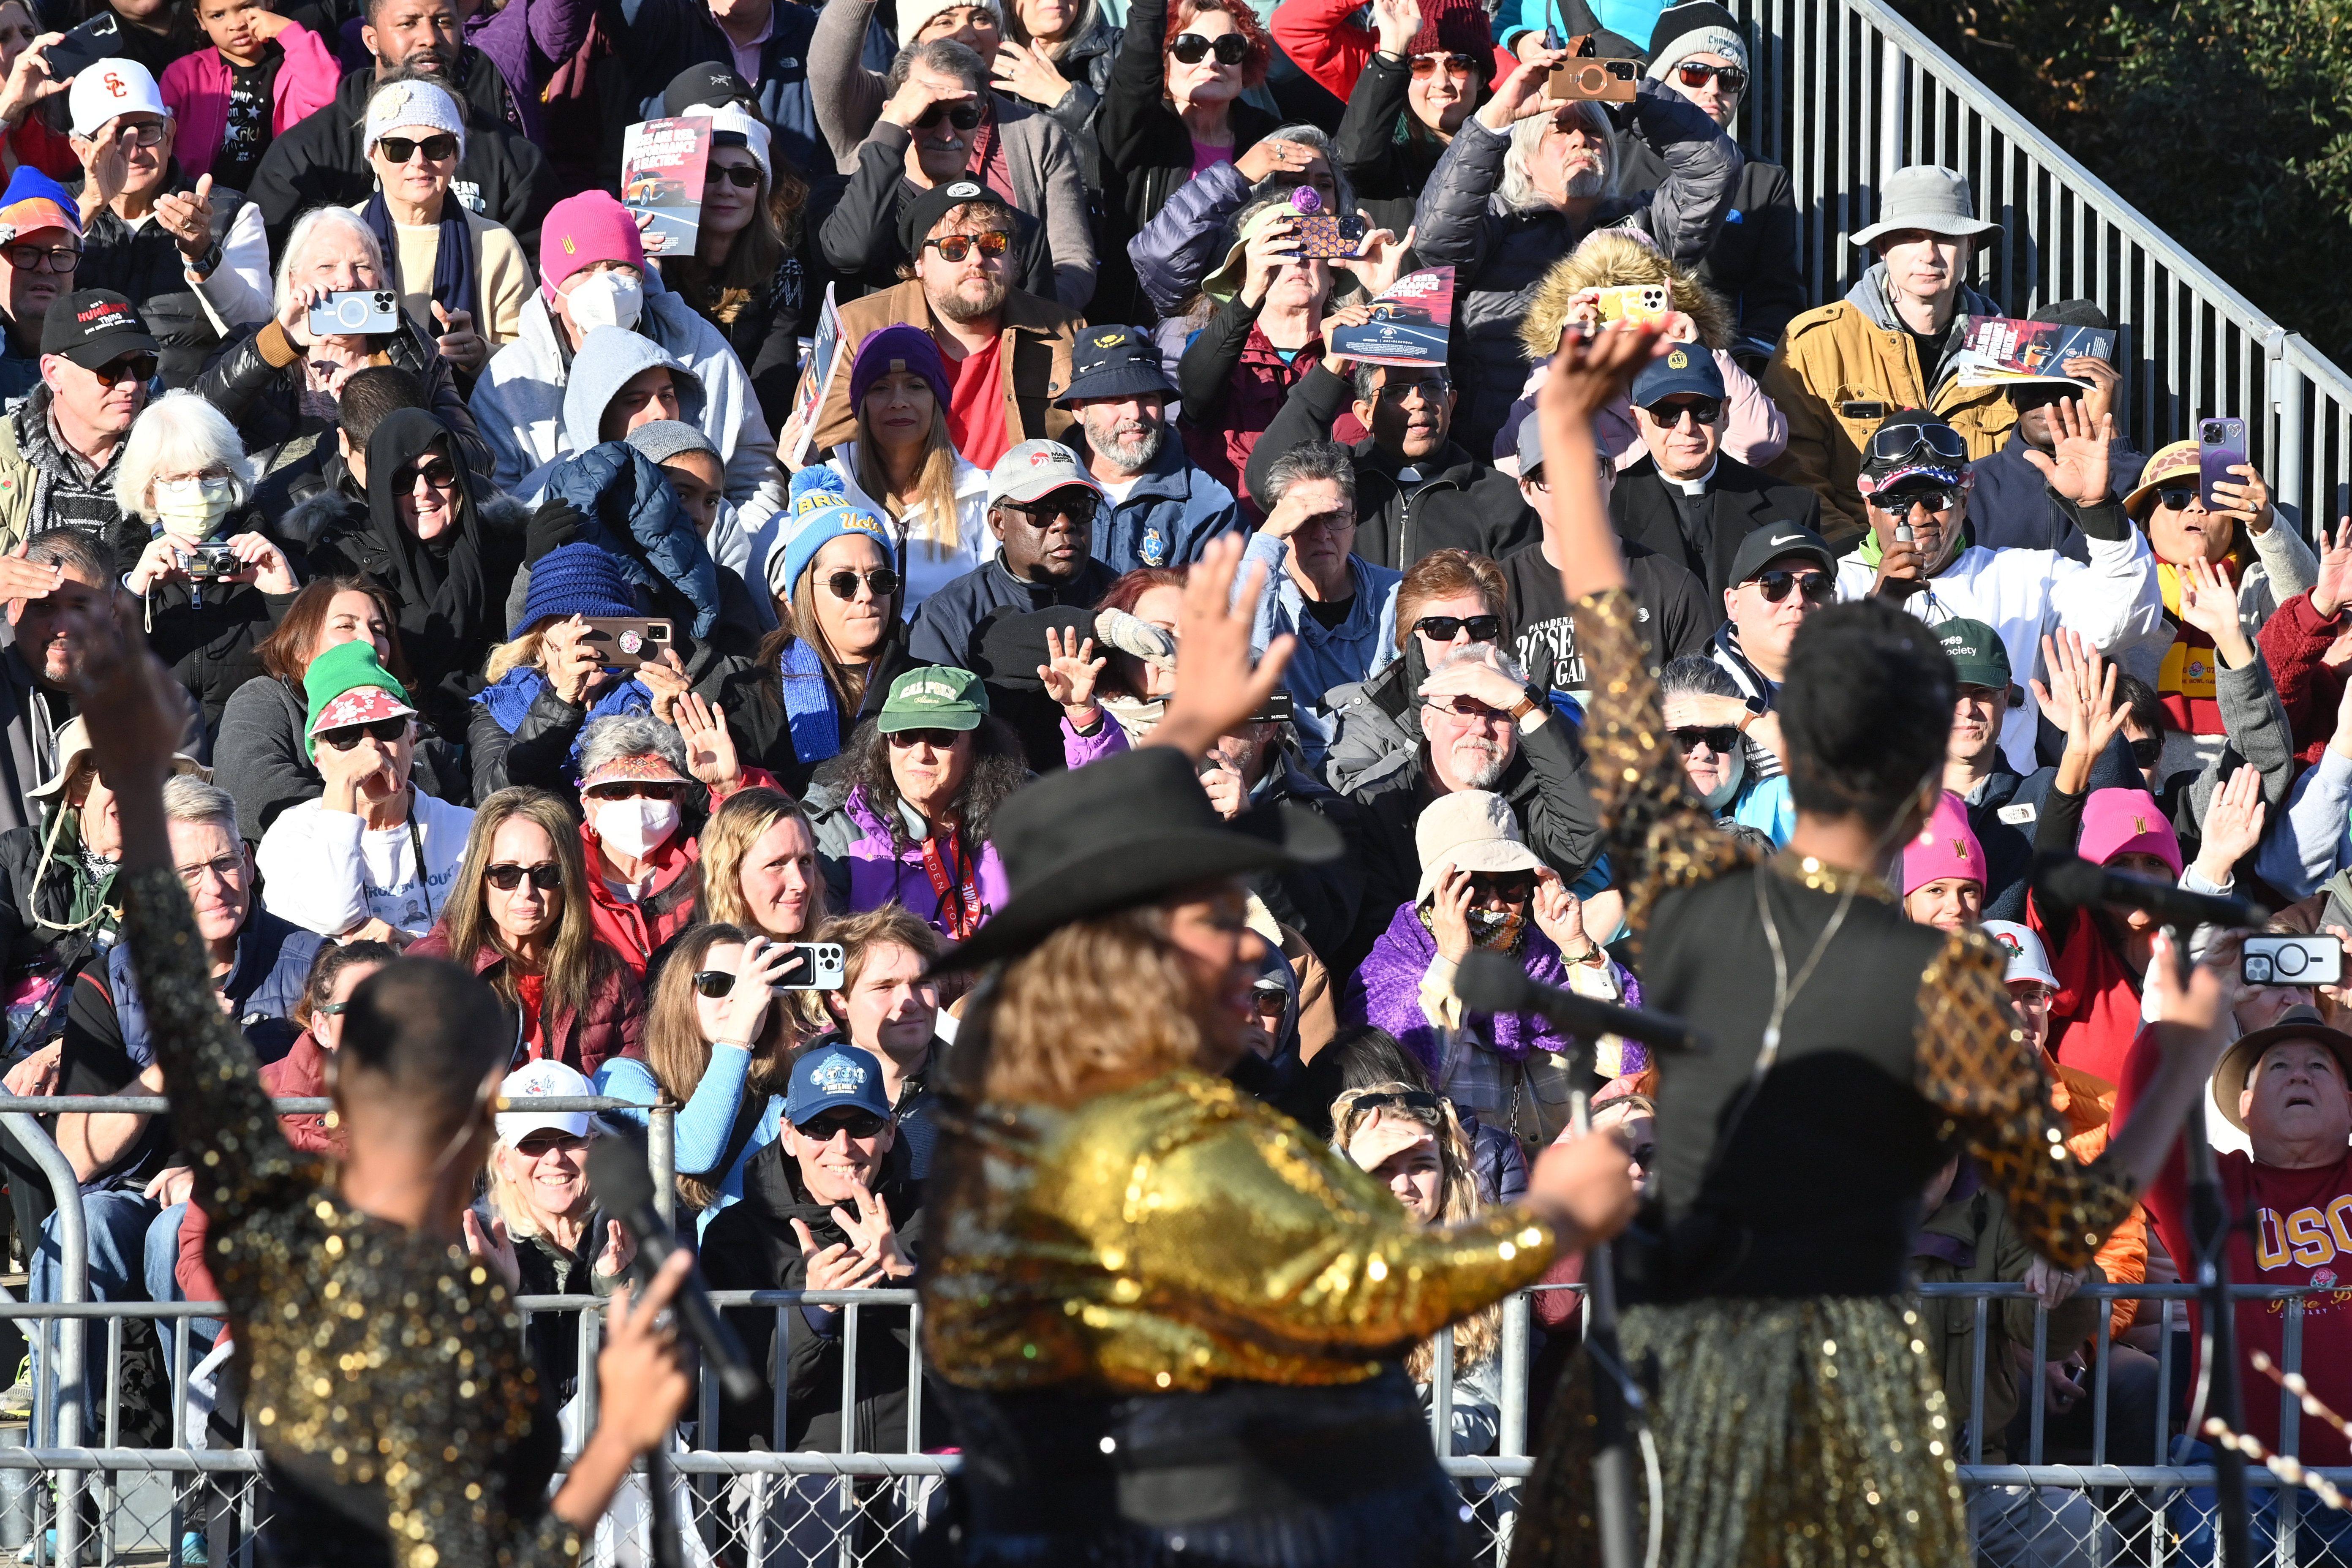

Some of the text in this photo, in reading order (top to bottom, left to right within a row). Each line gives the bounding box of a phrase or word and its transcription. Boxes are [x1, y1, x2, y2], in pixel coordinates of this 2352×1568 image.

[653, 130, 673, 144] ARE
[673, 128, 697, 142] RED.
[640, 153, 684, 170] ELECTRIC.
[1673, 355, 1682, 363] 33
[1528, 616, 1574, 634] PASADENA
[1939, 636, 1963, 646] 1769
[1946, 646, 1976, 656] ociety
[899, 681, 956, 700] CAL POLY
[914, 694, 940, 704] Alumni
[962, 882, 979, 913] GAME
